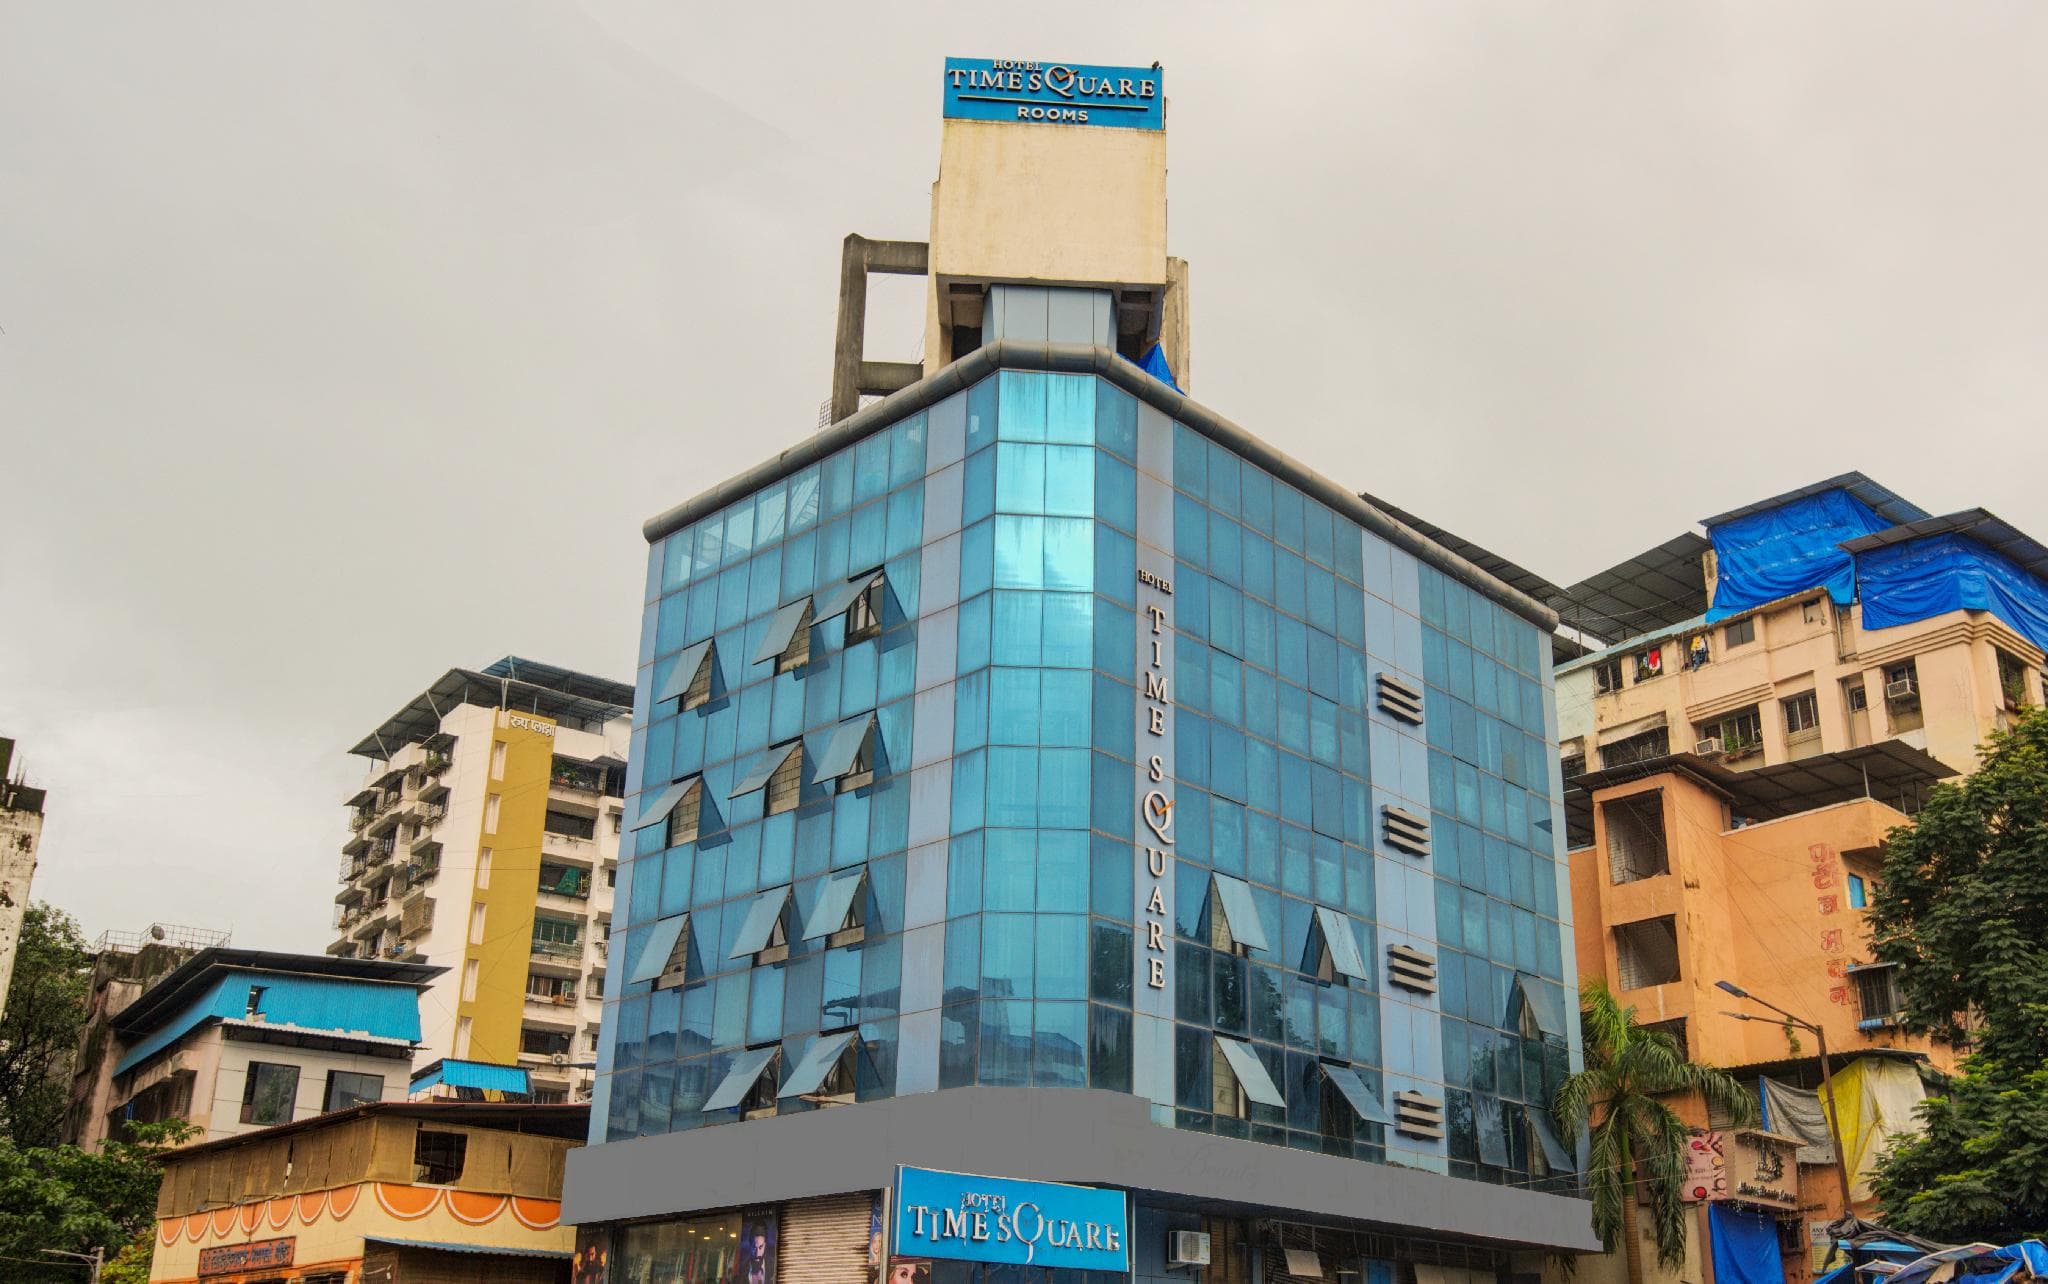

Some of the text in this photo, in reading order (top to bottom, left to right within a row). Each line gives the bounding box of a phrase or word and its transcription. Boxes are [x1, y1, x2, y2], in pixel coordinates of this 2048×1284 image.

[992, 59, 1043, 72] HOTEL
[1017, 106, 1089, 121] ROOMS
[1139, 569, 1173, 594] HOTEL
[1143, 605, 1176, 989] TIME SQUARE
[960, 1192, 1007, 1213] HOTEL
